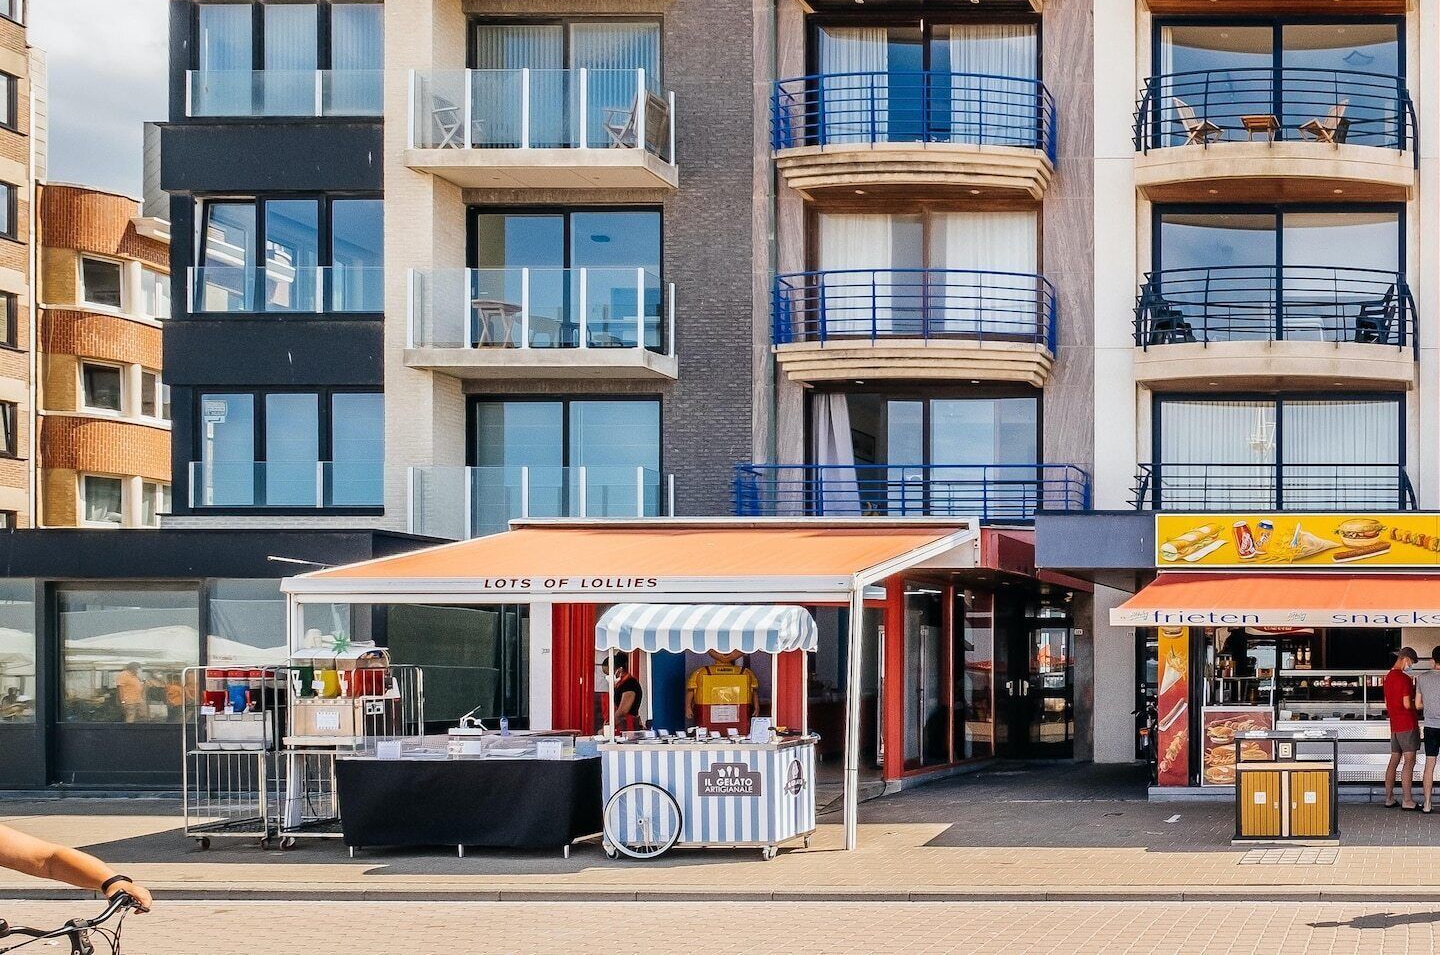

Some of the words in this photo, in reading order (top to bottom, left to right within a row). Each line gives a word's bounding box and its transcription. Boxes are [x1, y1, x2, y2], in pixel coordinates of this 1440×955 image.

[484, 578, 531, 589] LOTS
[544, 578, 569, 588] OF
[581, 578, 658, 588] LOLLIES
[1154, 610, 1259, 624] frieten
[704, 778, 713, 786] IL
[716, 778, 753, 786] GELATO
